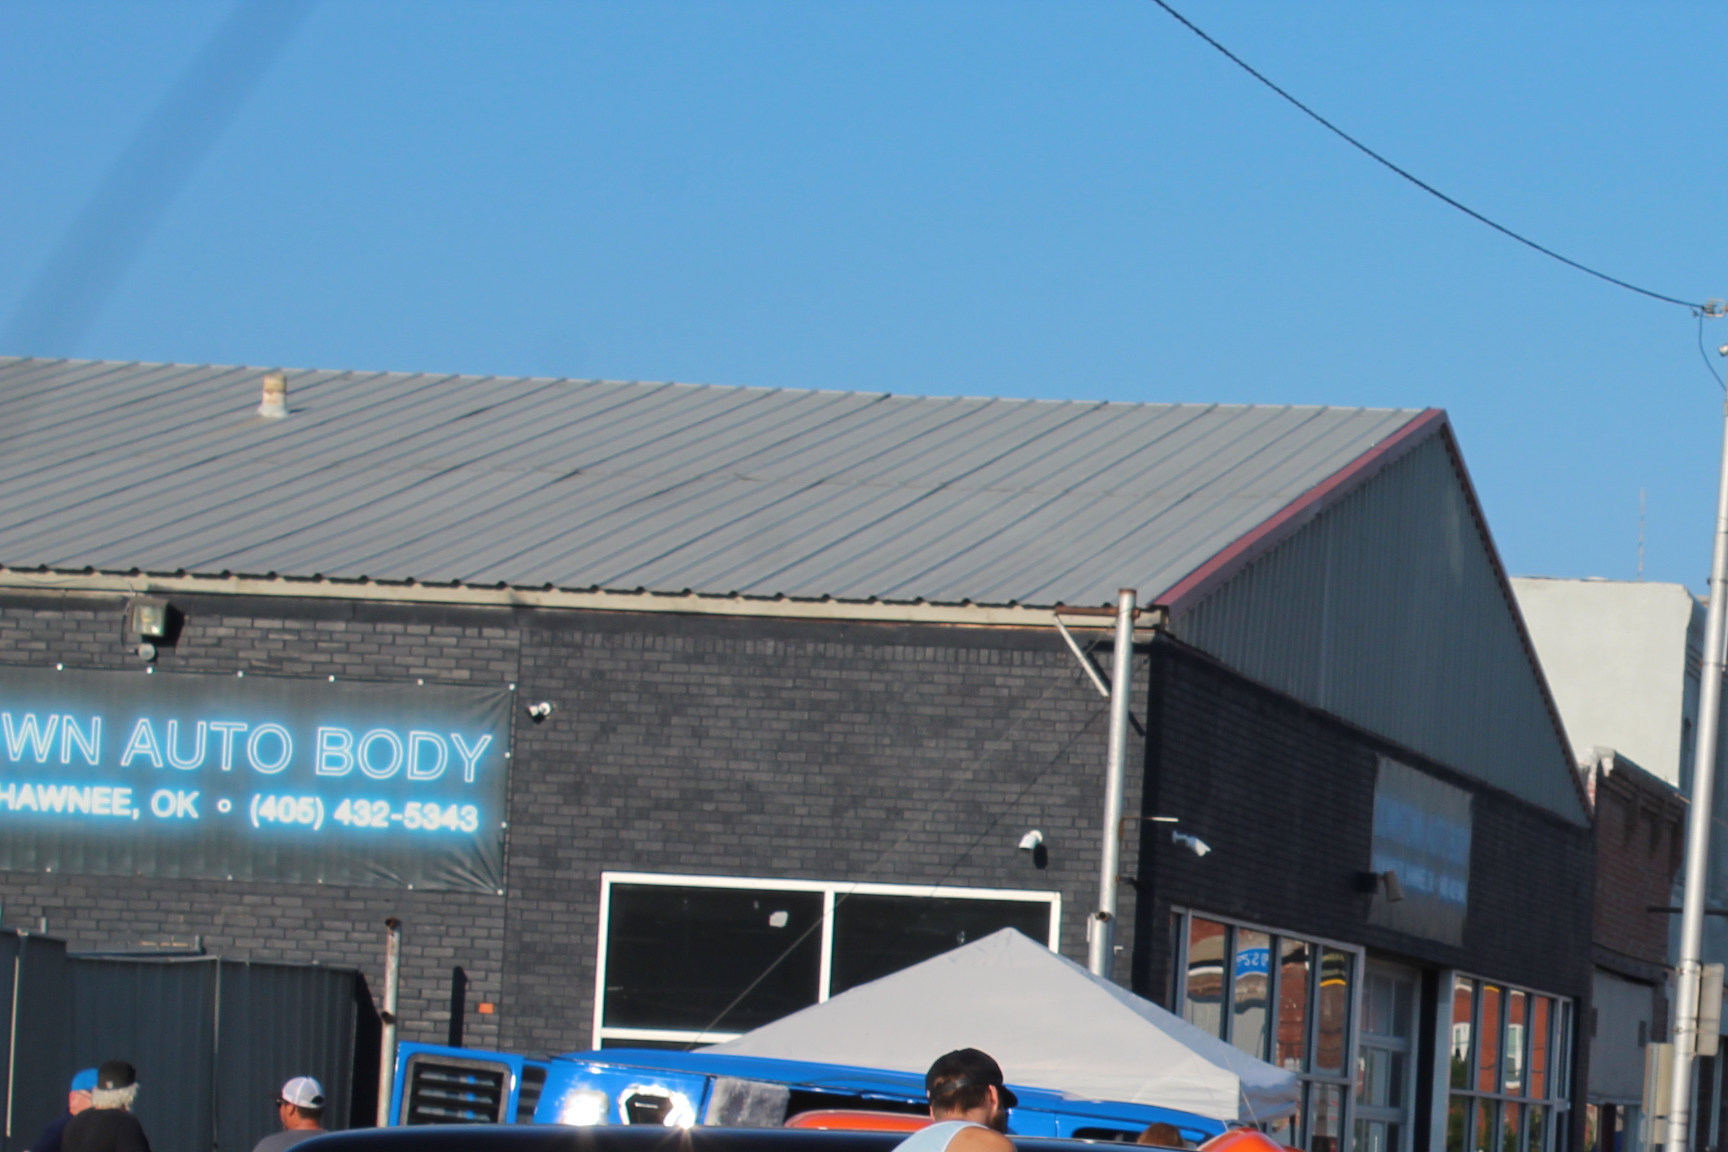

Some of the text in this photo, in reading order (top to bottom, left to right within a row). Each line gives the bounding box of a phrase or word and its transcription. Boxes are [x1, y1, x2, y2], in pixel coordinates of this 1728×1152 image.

[121, 718, 293, 774] AUTO
[315, 726, 493, 783] BODY
[150, 789, 200, 819] OK
[250, 792, 325, 831] (405)
[332, 797, 479, 834] 432-5343
